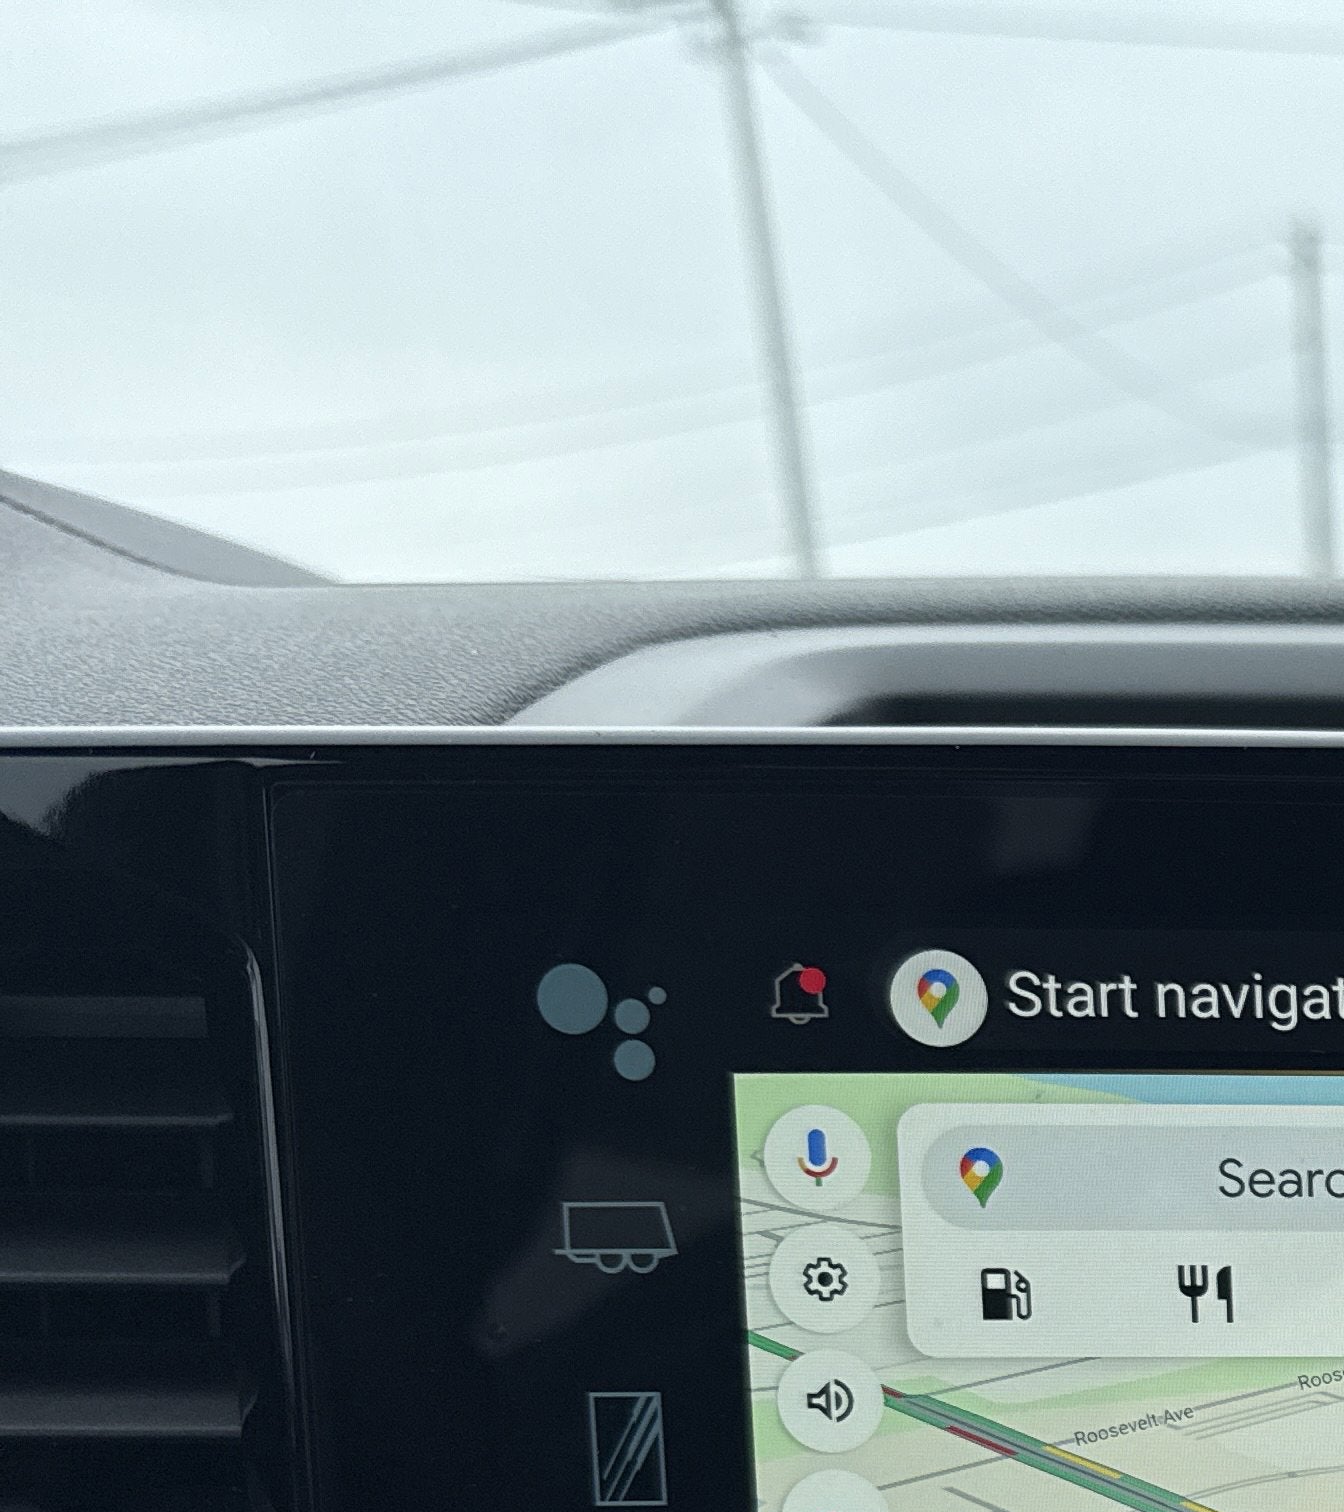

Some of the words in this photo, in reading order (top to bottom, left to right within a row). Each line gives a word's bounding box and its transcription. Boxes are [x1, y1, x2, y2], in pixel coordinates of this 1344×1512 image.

[1008, 971, 1138, 1020] Start
[1073, 1412, 1160, 1446] Roosevelt
[1163, 1405, 1195, 1425] Ave
